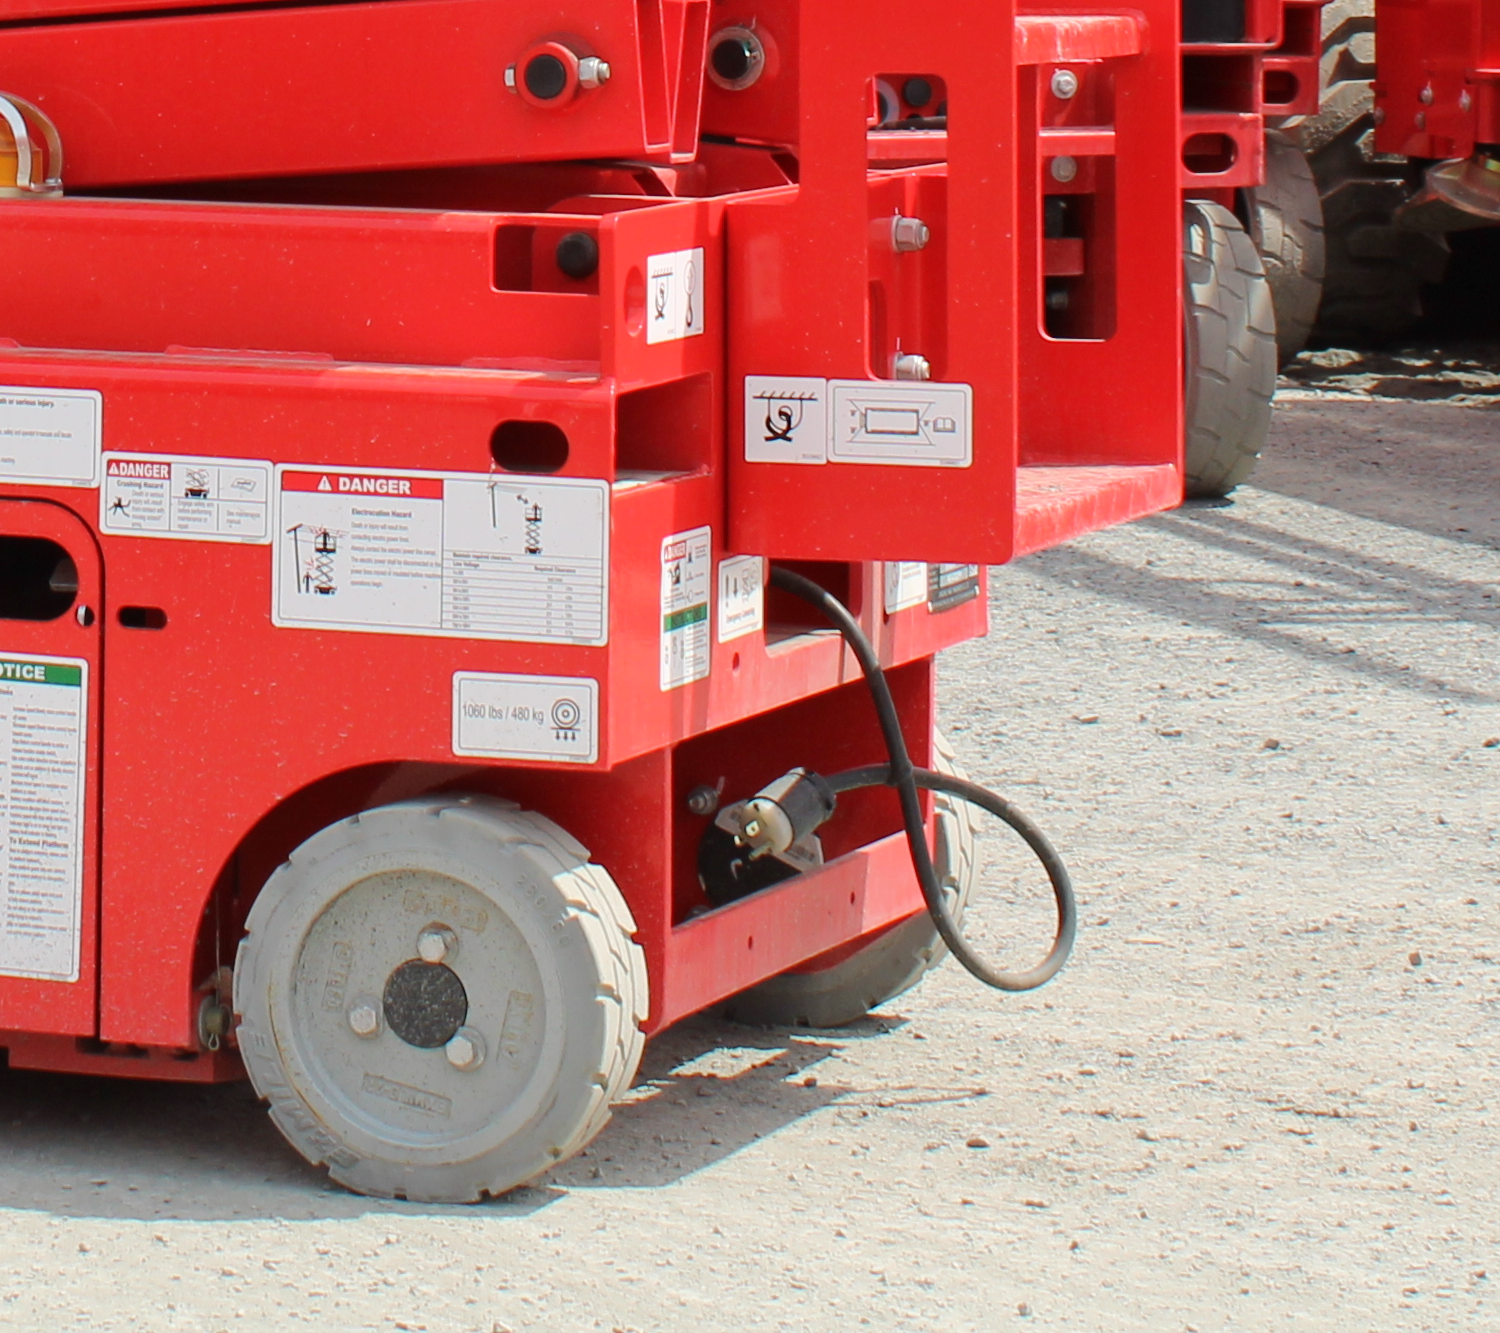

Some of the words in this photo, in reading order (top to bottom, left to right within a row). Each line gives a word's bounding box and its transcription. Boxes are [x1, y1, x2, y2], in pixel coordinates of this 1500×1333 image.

[120, 463, 168, 478] DANGER
[117, 480, 141, 489] Crushing
[144, 481, 163, 489] Hazard
[339, 477, 411, 494] DANGER
[352, 508, 390, 517] Electrocution
[392, 510, 412, 518] Hazard
[462, 704, 485, 719] 1060
[489, 705, 503, 720] lbs
[511, 706, 530, 721] 480
[533, 708, 544, 725] kg
